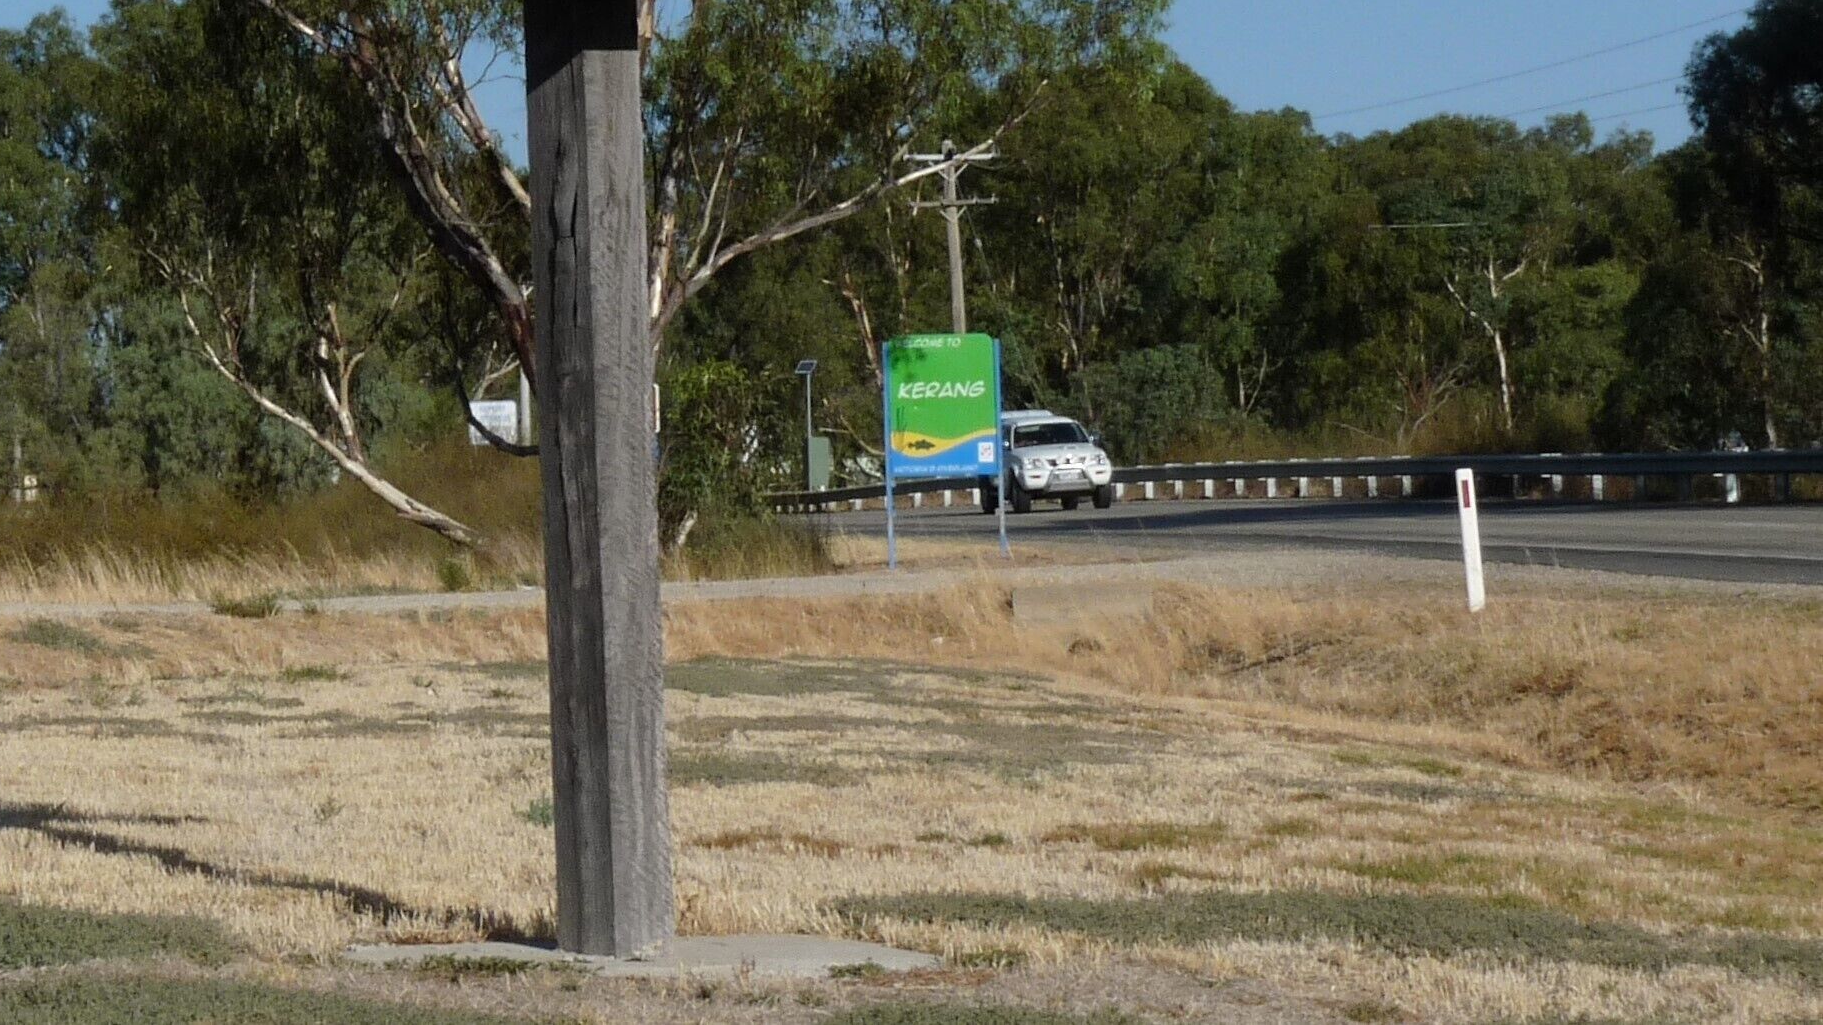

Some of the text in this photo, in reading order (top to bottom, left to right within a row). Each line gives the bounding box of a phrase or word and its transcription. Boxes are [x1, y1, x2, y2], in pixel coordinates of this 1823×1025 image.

[896, 337, 962, 348] ELCOME TO
[897, 380, 986, 399] KERANG
